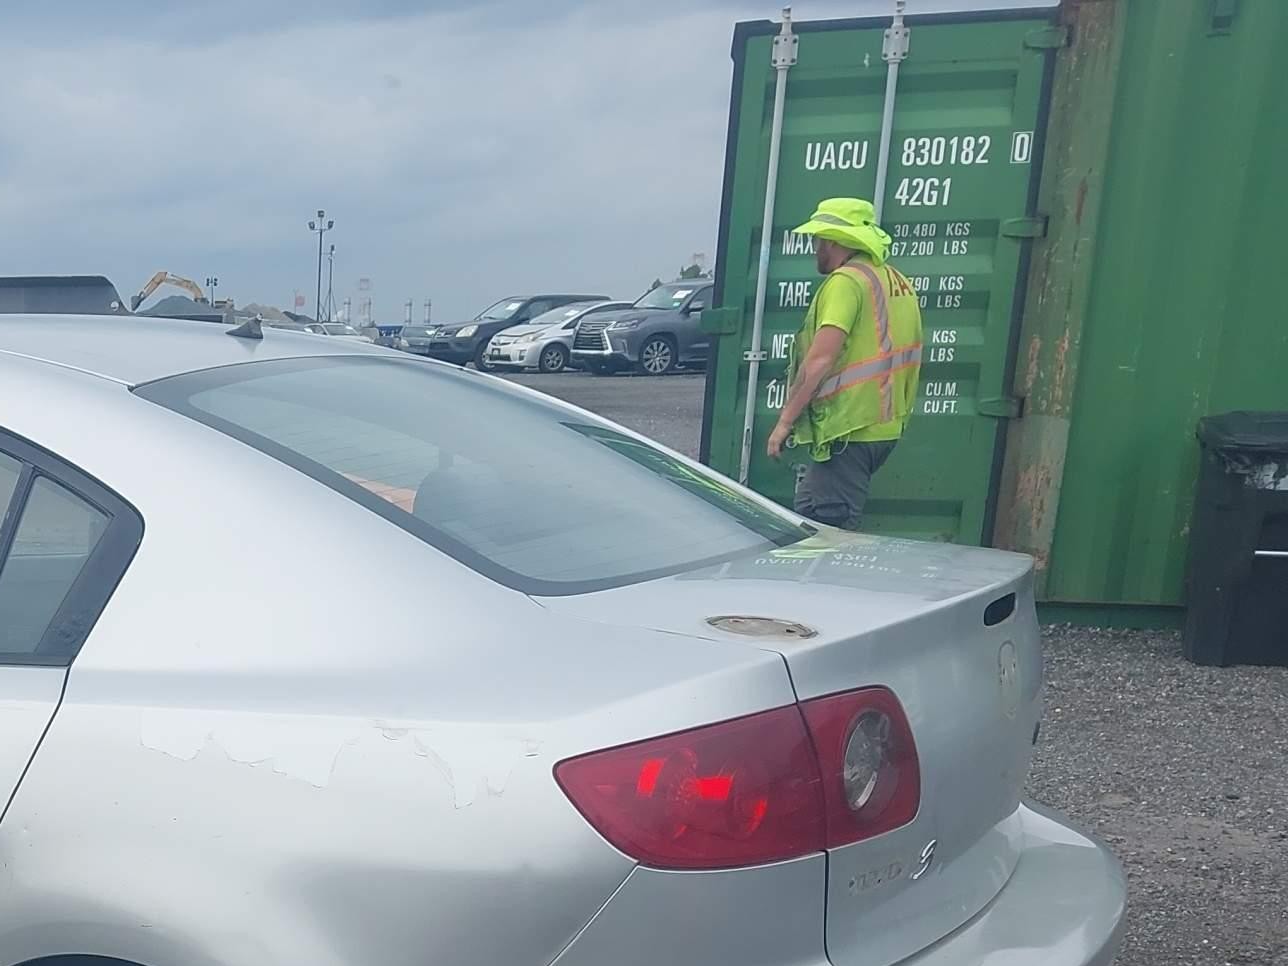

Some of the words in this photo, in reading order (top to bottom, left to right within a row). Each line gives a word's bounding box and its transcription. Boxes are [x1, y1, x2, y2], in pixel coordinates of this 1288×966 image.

[805, 141, 869, 170] UACU
[901, 135, 991, 166] 830182
[1013, 133, 1030, 162] 0
[895, 177, 952, 206] 42G1
[893, 223, 936, 238] 30.480
[945, 222, 971, 237] KGS
[782, 229, 817, 255] MAX.
[891, 240, 934, 256] 67.200
[943, 240, 968, 255] LBS
[939, 275, 964, 291] KGS
[778, 281, 812, 307] TARE
[936, 294, 962, 308] LBS
[932, 330, 957, 344] KGS
[929, 347, 955, 362] LBS
[925, 382, 959, 397] CU.M.
[923, 400, 958, 414] CU.FT.
